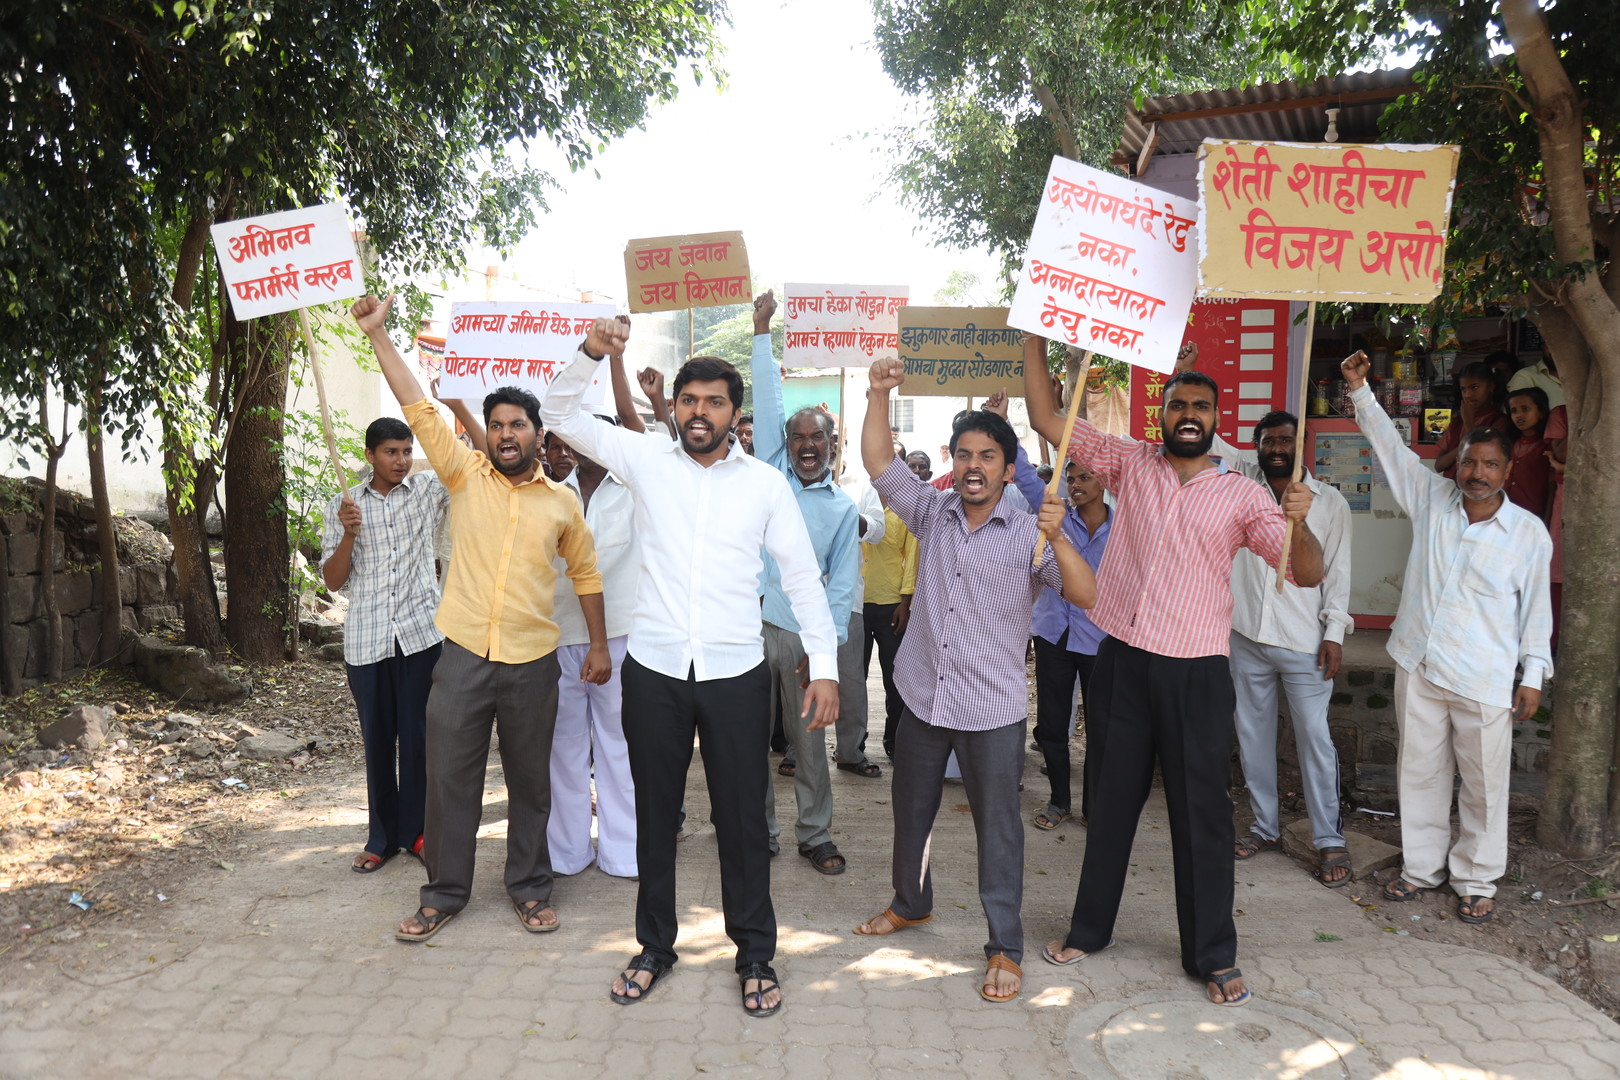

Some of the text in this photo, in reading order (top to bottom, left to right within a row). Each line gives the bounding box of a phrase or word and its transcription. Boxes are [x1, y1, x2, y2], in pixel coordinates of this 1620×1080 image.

[1213, 146, 1426, 215] शेती शाहीचा
[228, 223, 315, 263] अभिनव
[634, 242, 731, 271] जय जवान
[1077, 231, 1138, 276] नका.
[1240, 207, 1354, 273] विजय
[231, 260, 353, 300] फार्मर्स क्लब
[640, 271, 752, 305] जय किसान.
[451, 314, 508, 335] आमच्या
[507, 310, 550, 335] जमिनी
[550, 312, 571, 336] घेऊ
[787, 296, 825, 320] तुमचा
[826, 290, 854, 316] हेका
[786, 327, 821, 349] आमचं
[900, 327, 950, 352] झुकणार
[950, 323, 978, 349] नाही
[1090, 317, 1144, 355] नका.
[444, 350, 491, 388] पोटावर
[492, 357, 525, 383] लाथ
[968, 352, 1014, 379] सोडणार
